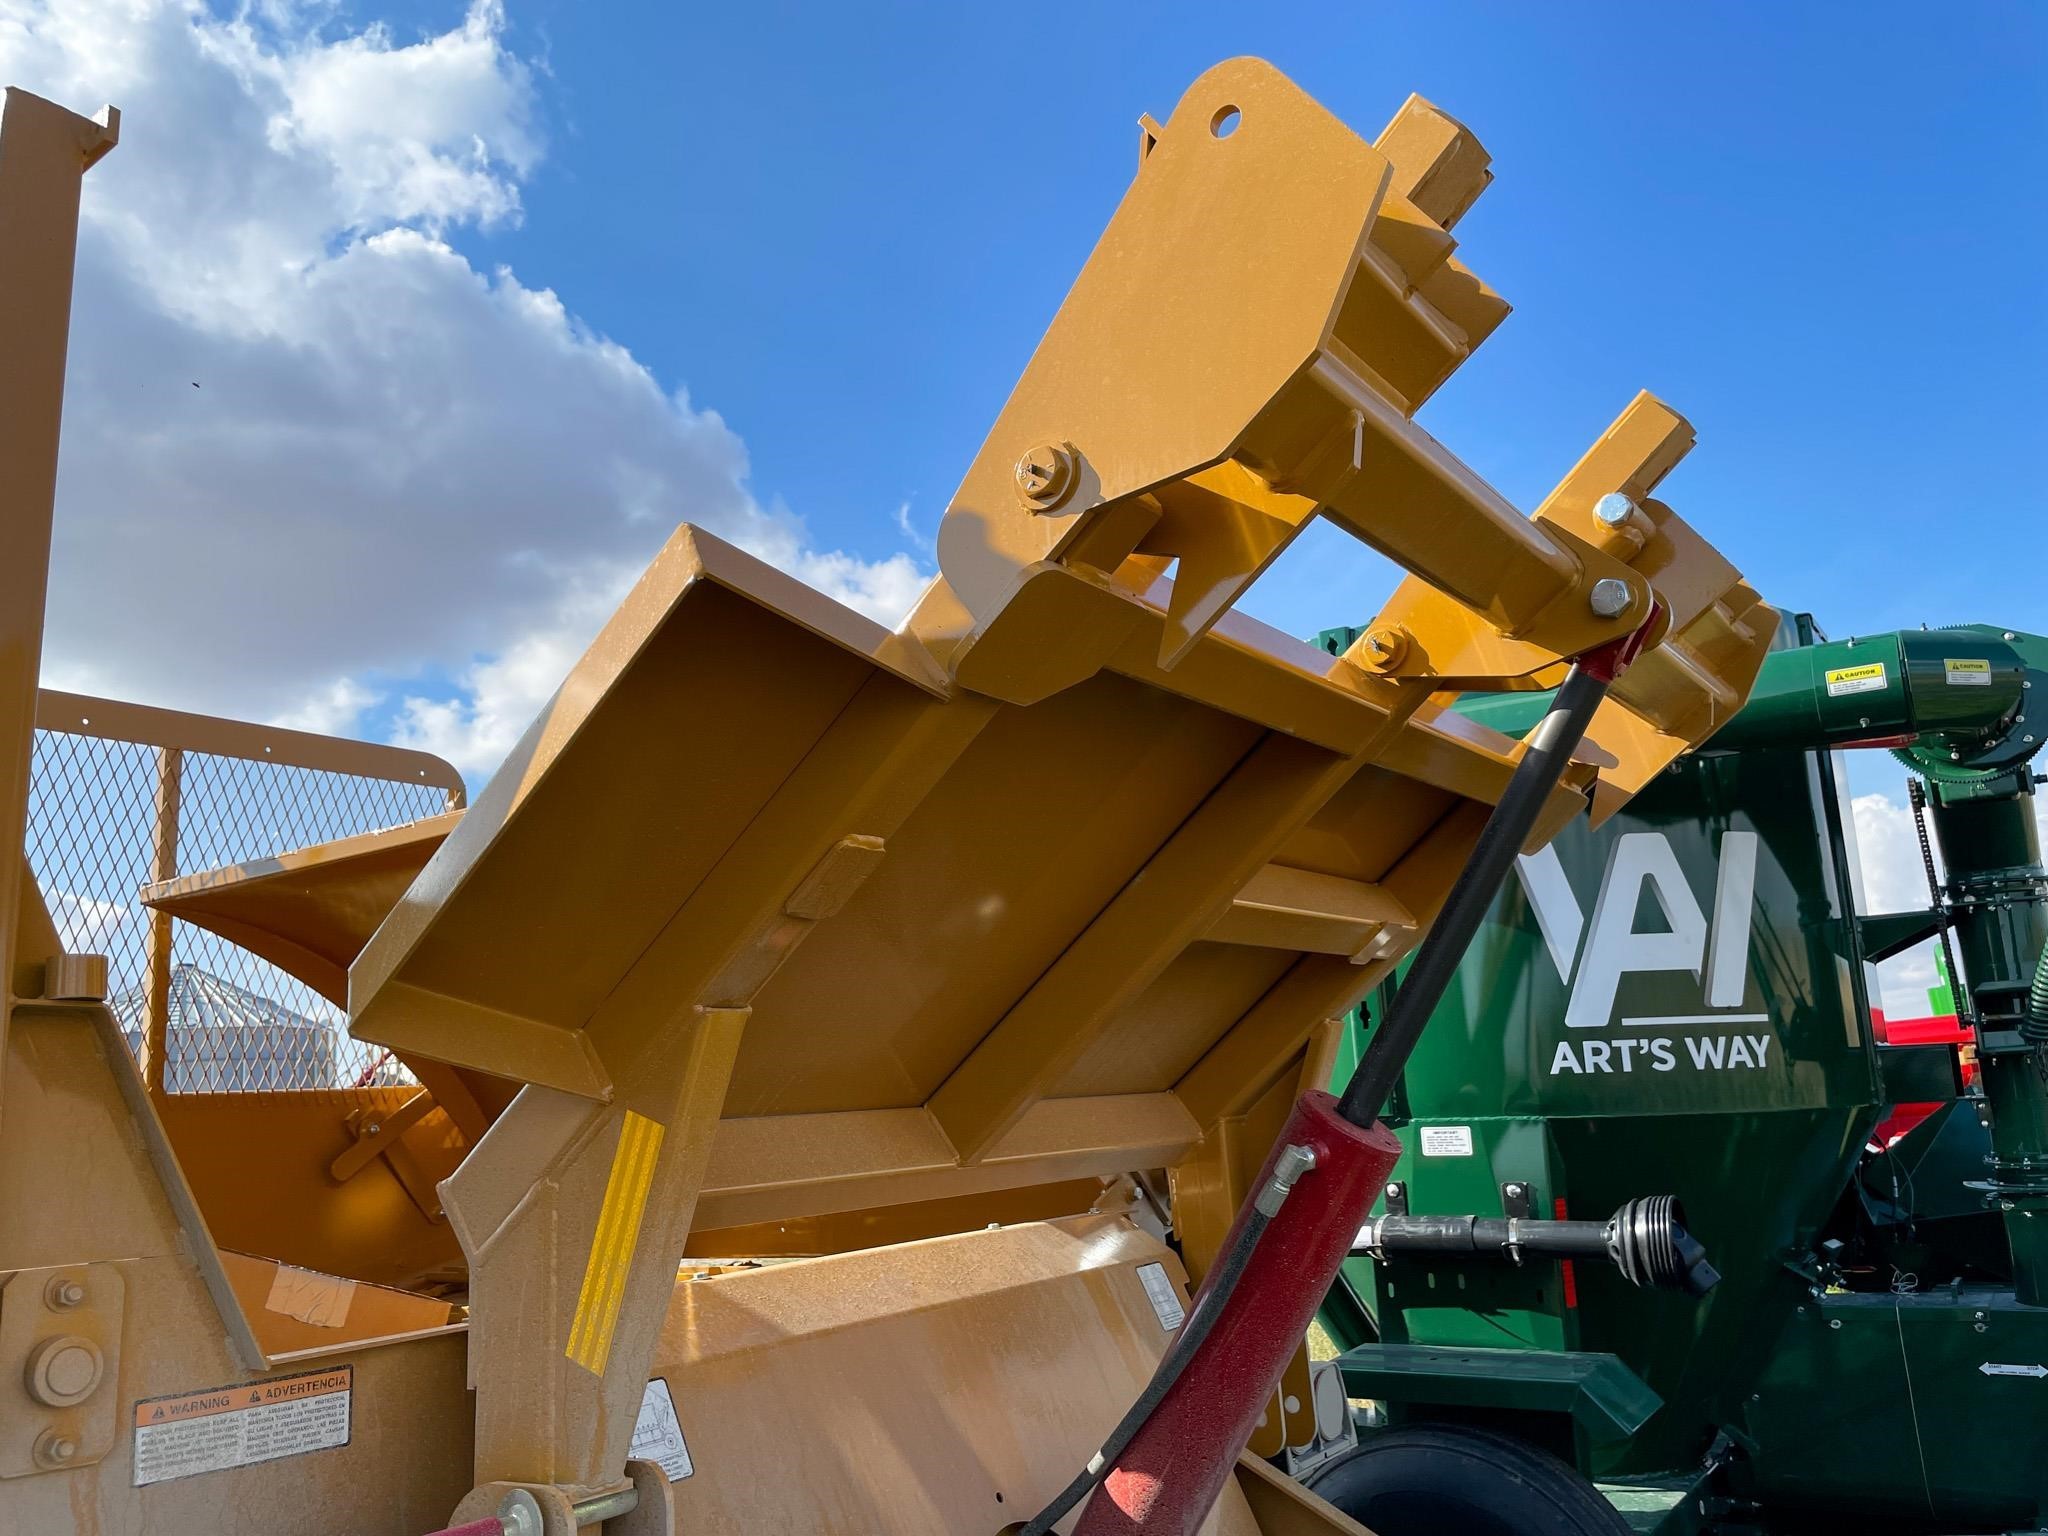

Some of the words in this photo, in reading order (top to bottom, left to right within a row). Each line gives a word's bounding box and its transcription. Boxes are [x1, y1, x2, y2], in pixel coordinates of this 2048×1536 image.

[1845, 669, 1876, 678] CAUTION
[1550, 1038, 1676, 1075] ART'S
[1684, 1035, 1770, 1071] WAY
[266, 1376, 346, 1398] ADVERTENCIA
[170, 1396, 230, 1414] WARNING
